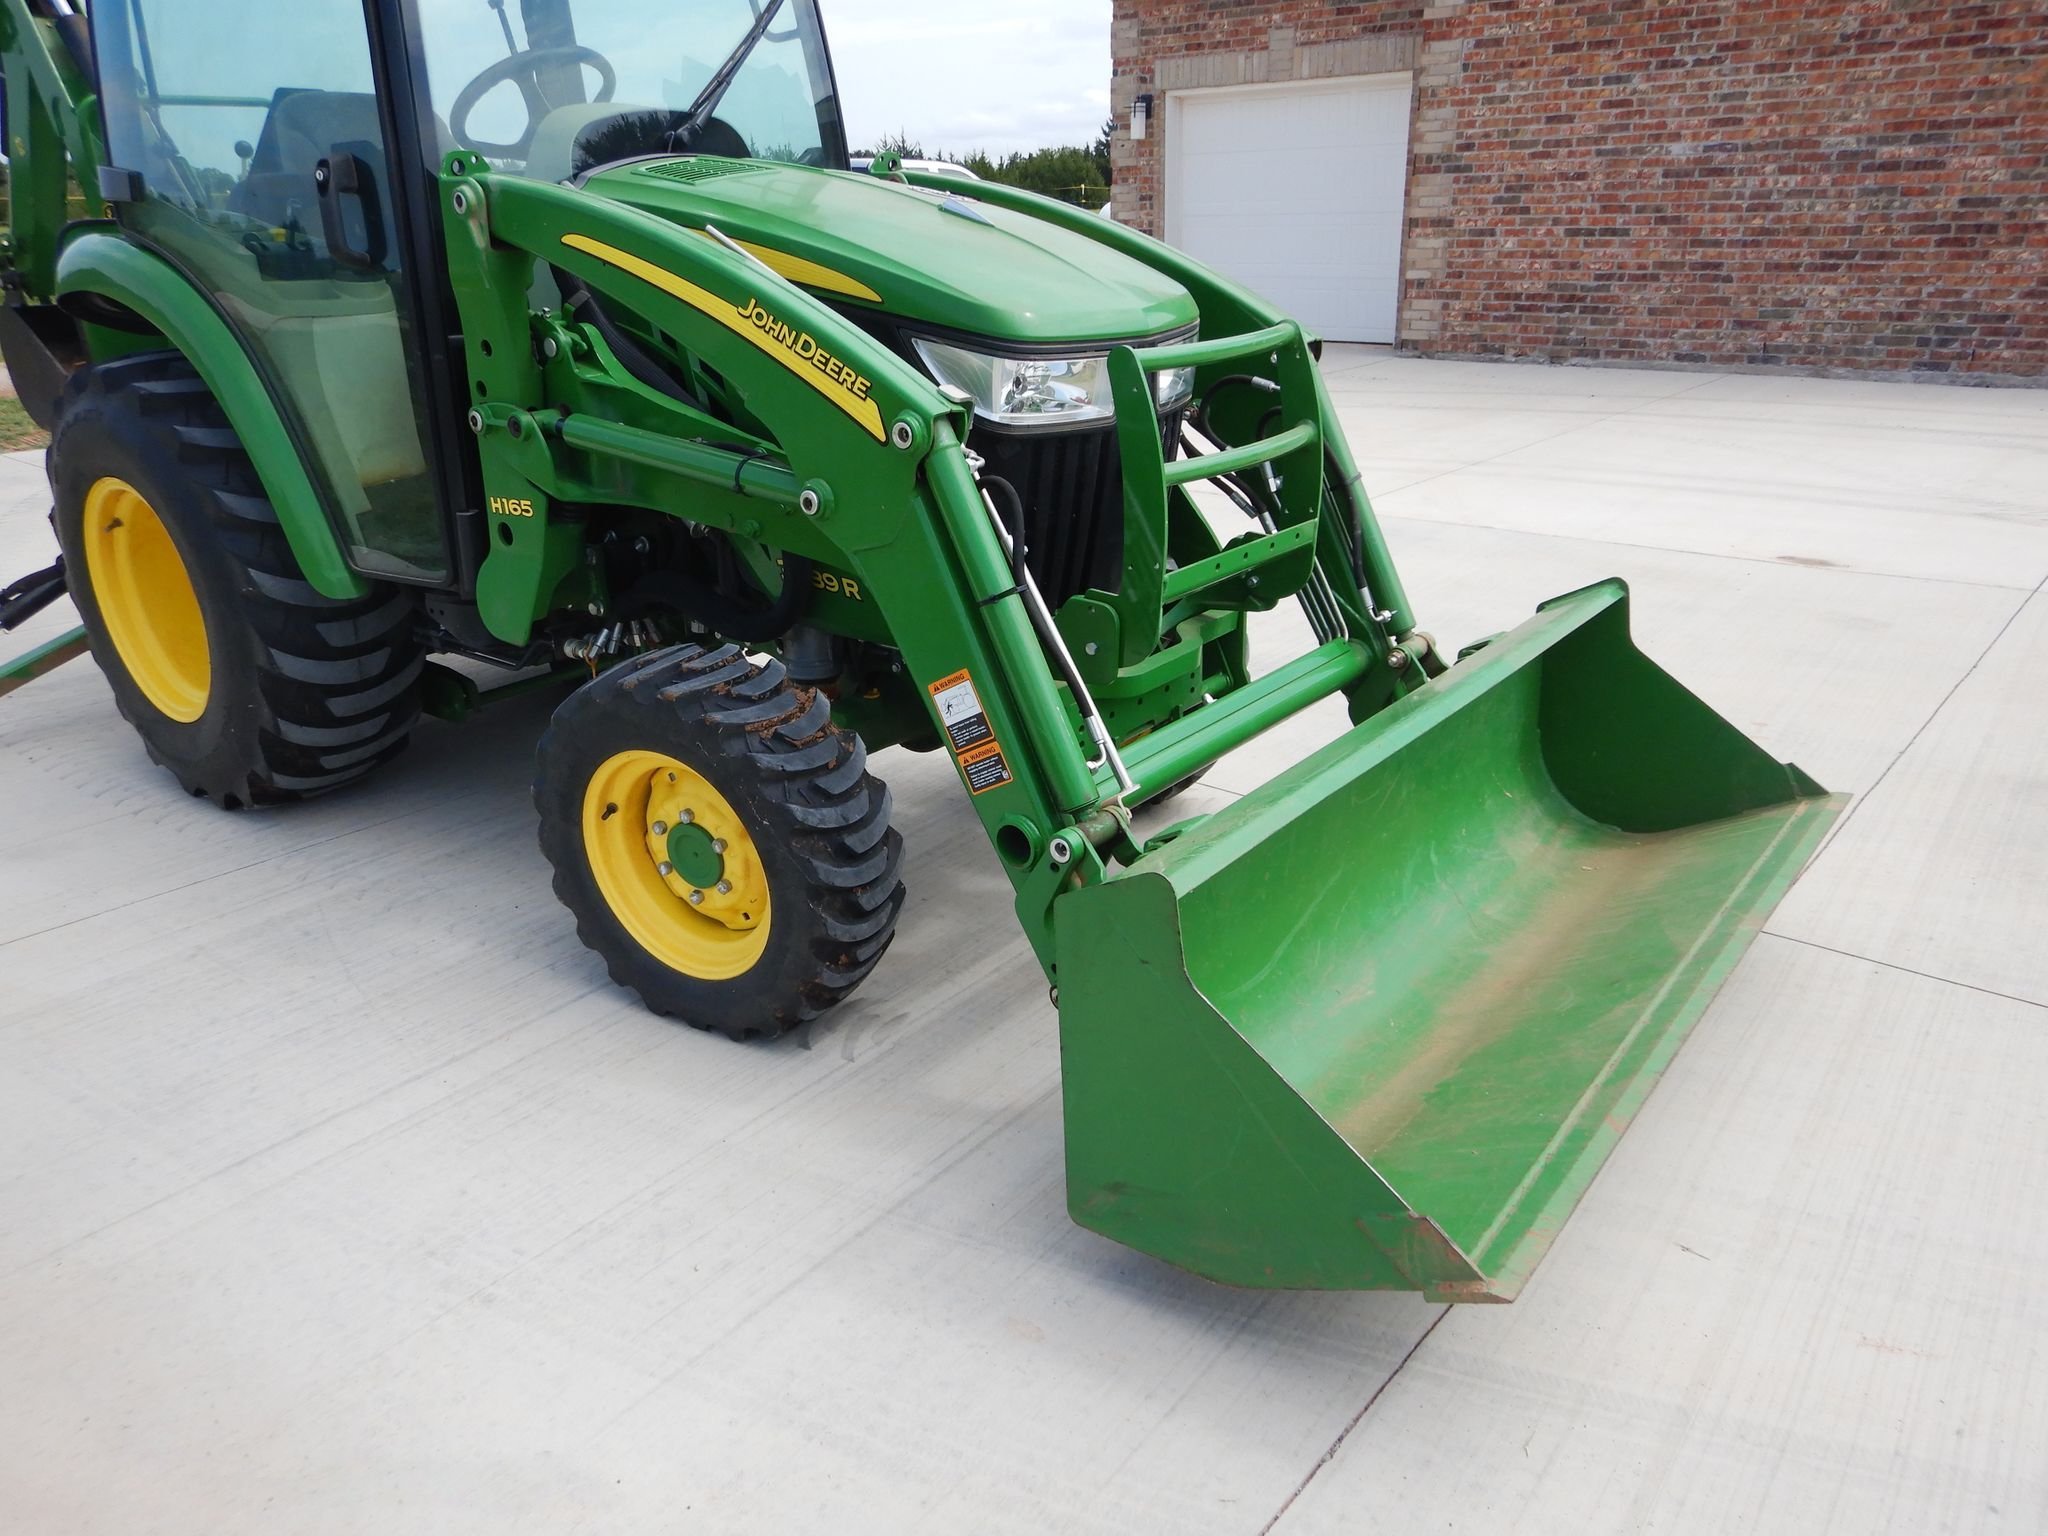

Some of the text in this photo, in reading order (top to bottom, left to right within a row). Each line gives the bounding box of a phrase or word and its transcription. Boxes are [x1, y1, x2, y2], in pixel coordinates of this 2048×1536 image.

[737, 298, 872, 400] JOHN DEERE
[489, 496, 534, 518] H165
[939, 673, 965, 689] WARNING
[969, 746, 996, 762] WARNING
